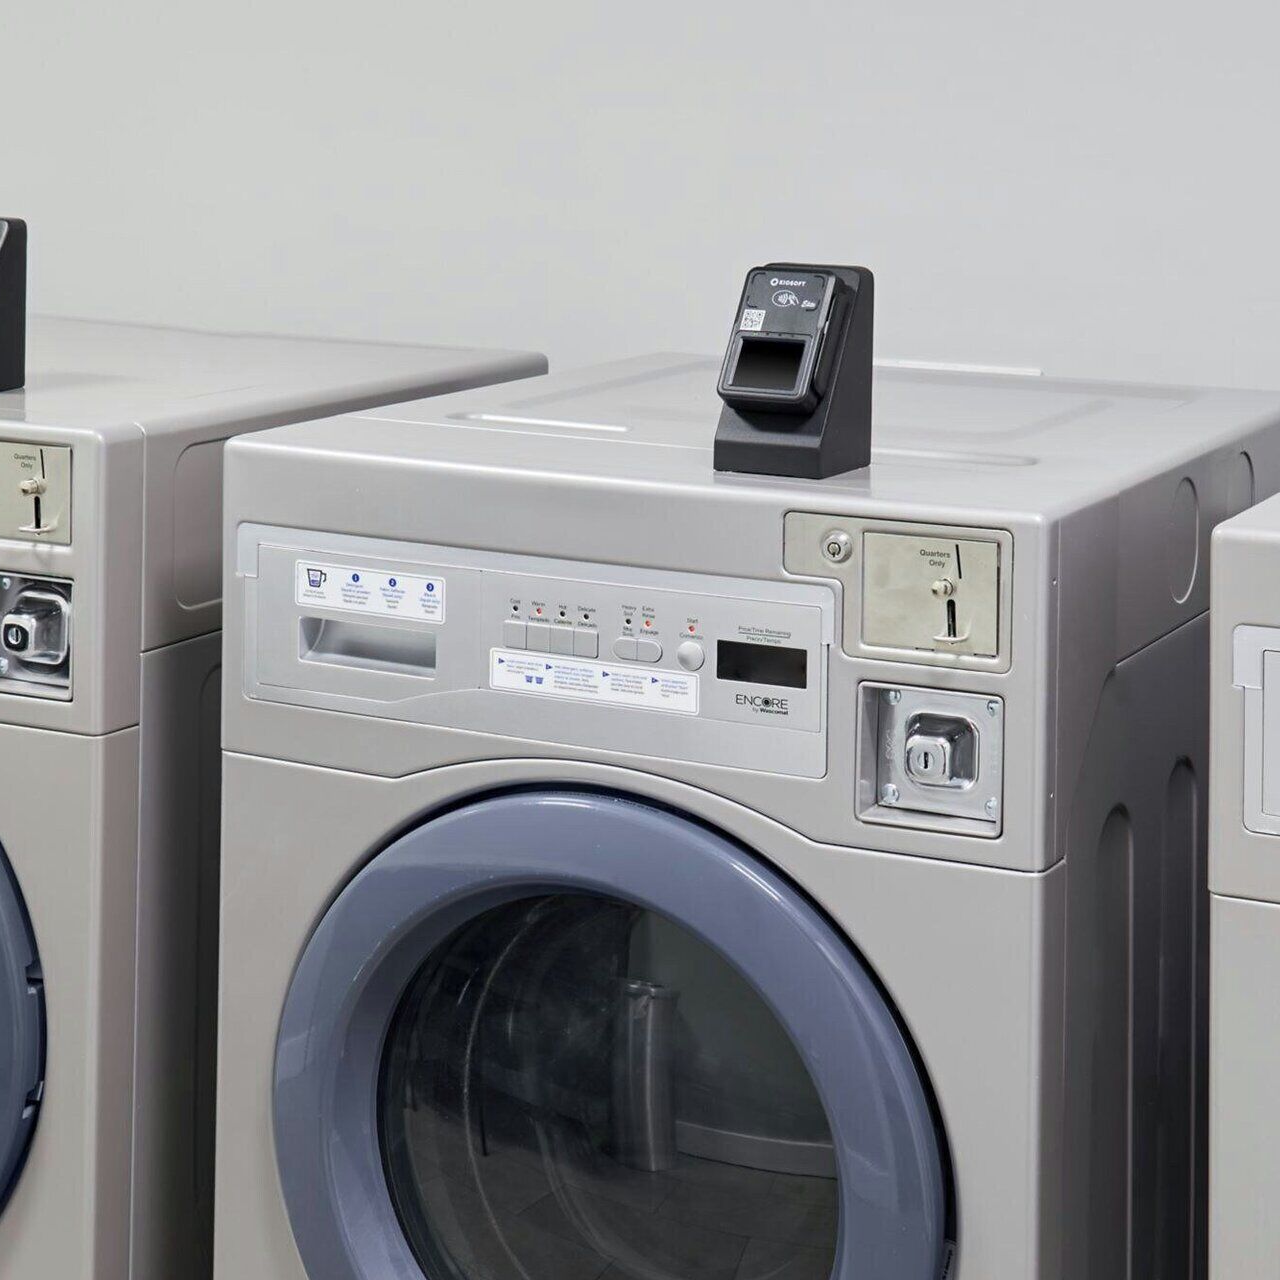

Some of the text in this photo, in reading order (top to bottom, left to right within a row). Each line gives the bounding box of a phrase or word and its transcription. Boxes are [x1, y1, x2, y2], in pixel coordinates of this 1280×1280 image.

[919, 549, 951, 558] Quarters
[929, 559, 946, 568] Only
[735, 694, 789, 710] ENCORE
